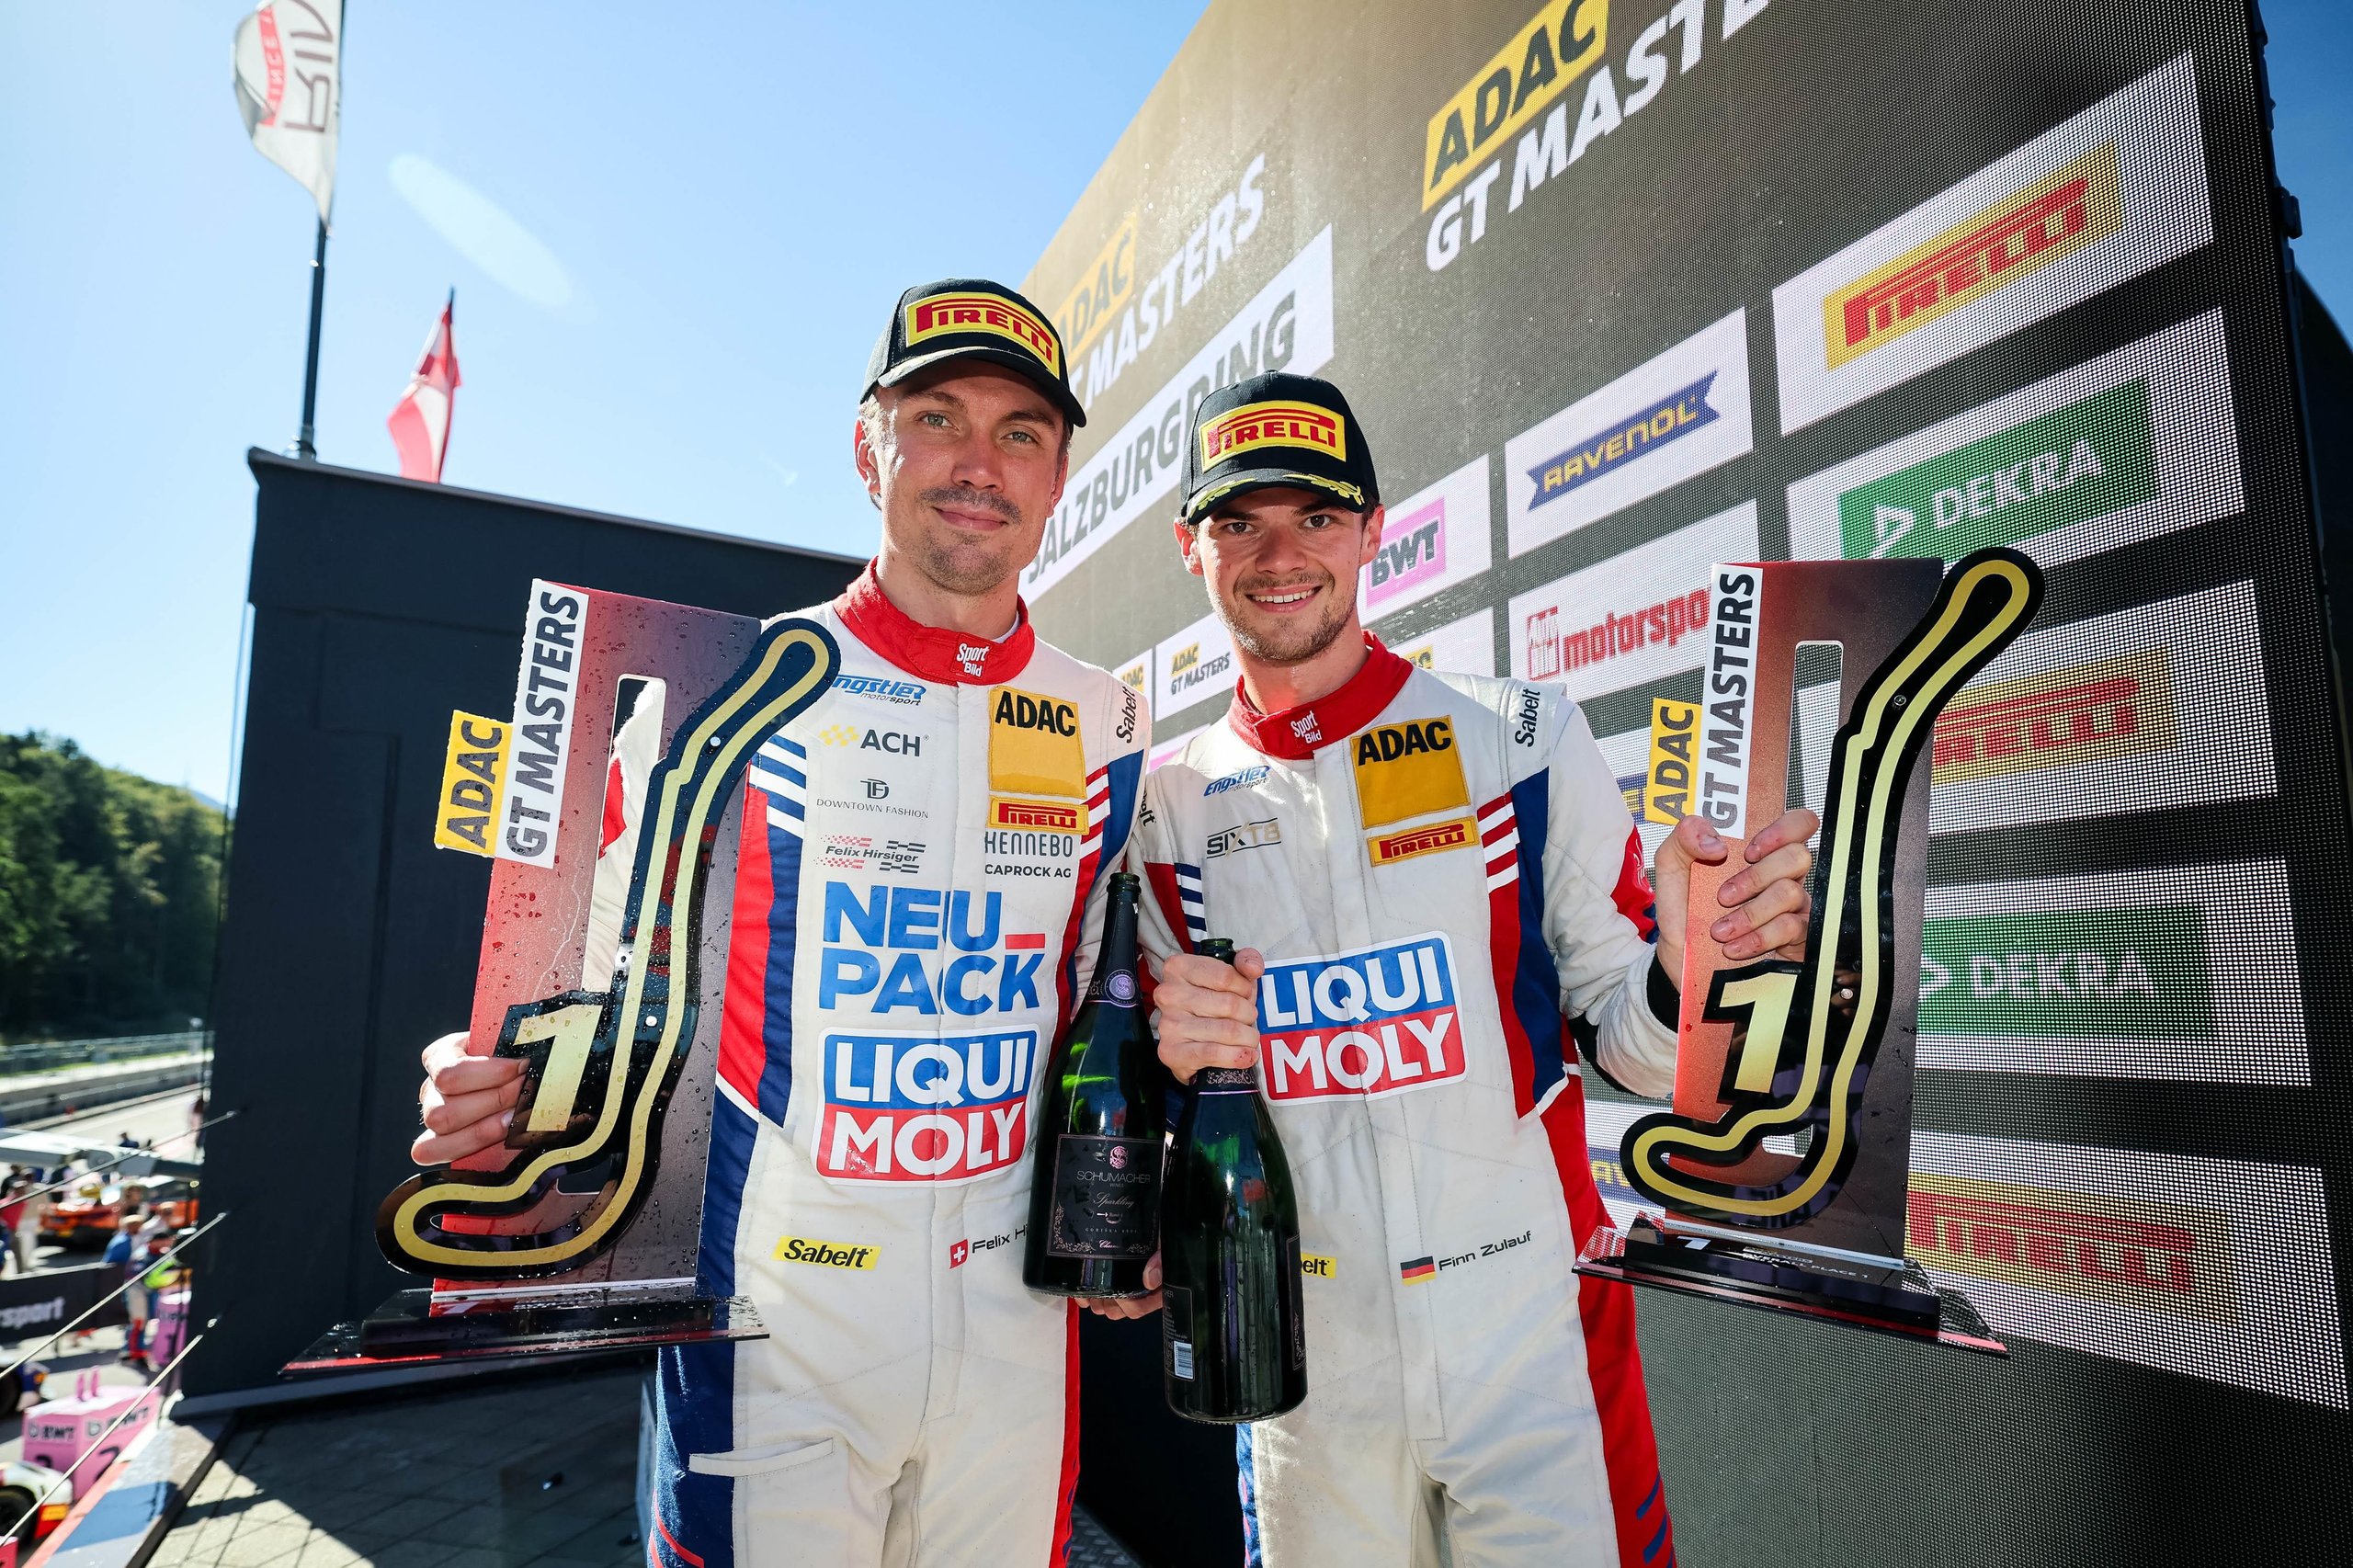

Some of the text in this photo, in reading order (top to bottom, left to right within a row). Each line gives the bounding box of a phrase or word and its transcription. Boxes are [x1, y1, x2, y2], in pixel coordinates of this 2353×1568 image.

[1430, 0, 1596, 190] ADAC
[1427, 162, 1500, 271] GT
[1084, 152, 1266, 411] MASTERS
[1844, 178, 2088, 347] PIRELLI
[916, 298, 1053, 363] PIRELLI
[1207, 408, 1336, 459] PIRELLI
[1543, 401, 1698, 494] RAVENOL
[1934, 438, 2103, 528] DEKRA
[1370, 518, 1439, 588] BWT
[956, 642, 990, 665] Sport
[1563, 588, 1710, 673] motorspo
[963, 662, 983, 677] Bild
[1172, 644, 1199, 675] ADAC
[1184, 652, 1232, 690] MASTERS
[832, 674, 928, 700] ngstler
[860, 692, 921, 706] motorsport
[995, 691, 1076, 737] ADAC
[1702, 574, 1755, 830] GT MASTERS
[506, 591, 580, 858] GT MASTERS
[1116, 686, 1138, 744] Sabelt
[1290, 710, 1319, 738] Sport
[1305, 729, 1324, 744] Bild
[1515, 686, 1541, 748] Sabelt
[1931, 675, 2140, 766] RELLI
[1358, 721, 1452, 767] ADAC
[1653, 705, 1694, 826] ADAC
[447, 720, 503, 849] ADAC
[816, 798, 929, 820] DOWNTOWN FASHION
[998, 802, 1078, 829] PIRELLI
[1380, 823, 1466, 860] PIRELLI
[824, 845, 919, 863] Felix Hirsiger
[984, 831, 1074, 858] HENNEBO
[984, 863, 1072, 879] CAPROCK AG
[818, 947, 1046, 1016] PACK
[1261, 946, 1444, 1028] LIQUI
[1971, 951, 2154, 995] DEKRA
[1270, 1012, 1455, 1094] MOLY
[1719, 971, 1799, 1094] 1
[513, 1004, 604, 1132] 1
[835, 1038, 1029, 1108] LIQUI
[828, 1101, 1025, 1176] MOLY
[1076, 1170, 1151, 1184] SCHUMACHER
[1093, 1191, 1135, 1210] Sparkling
[783, 1238, 870, 1268] Sabelt
[972, 1233, 1011, 1254] Felix
[1438, 1230, 1533, 1271] Finn Zulauf
[1907, 1190, 2198, 1292] PIRELLI
[1811, 1264, 1858, 1278] PLACE
